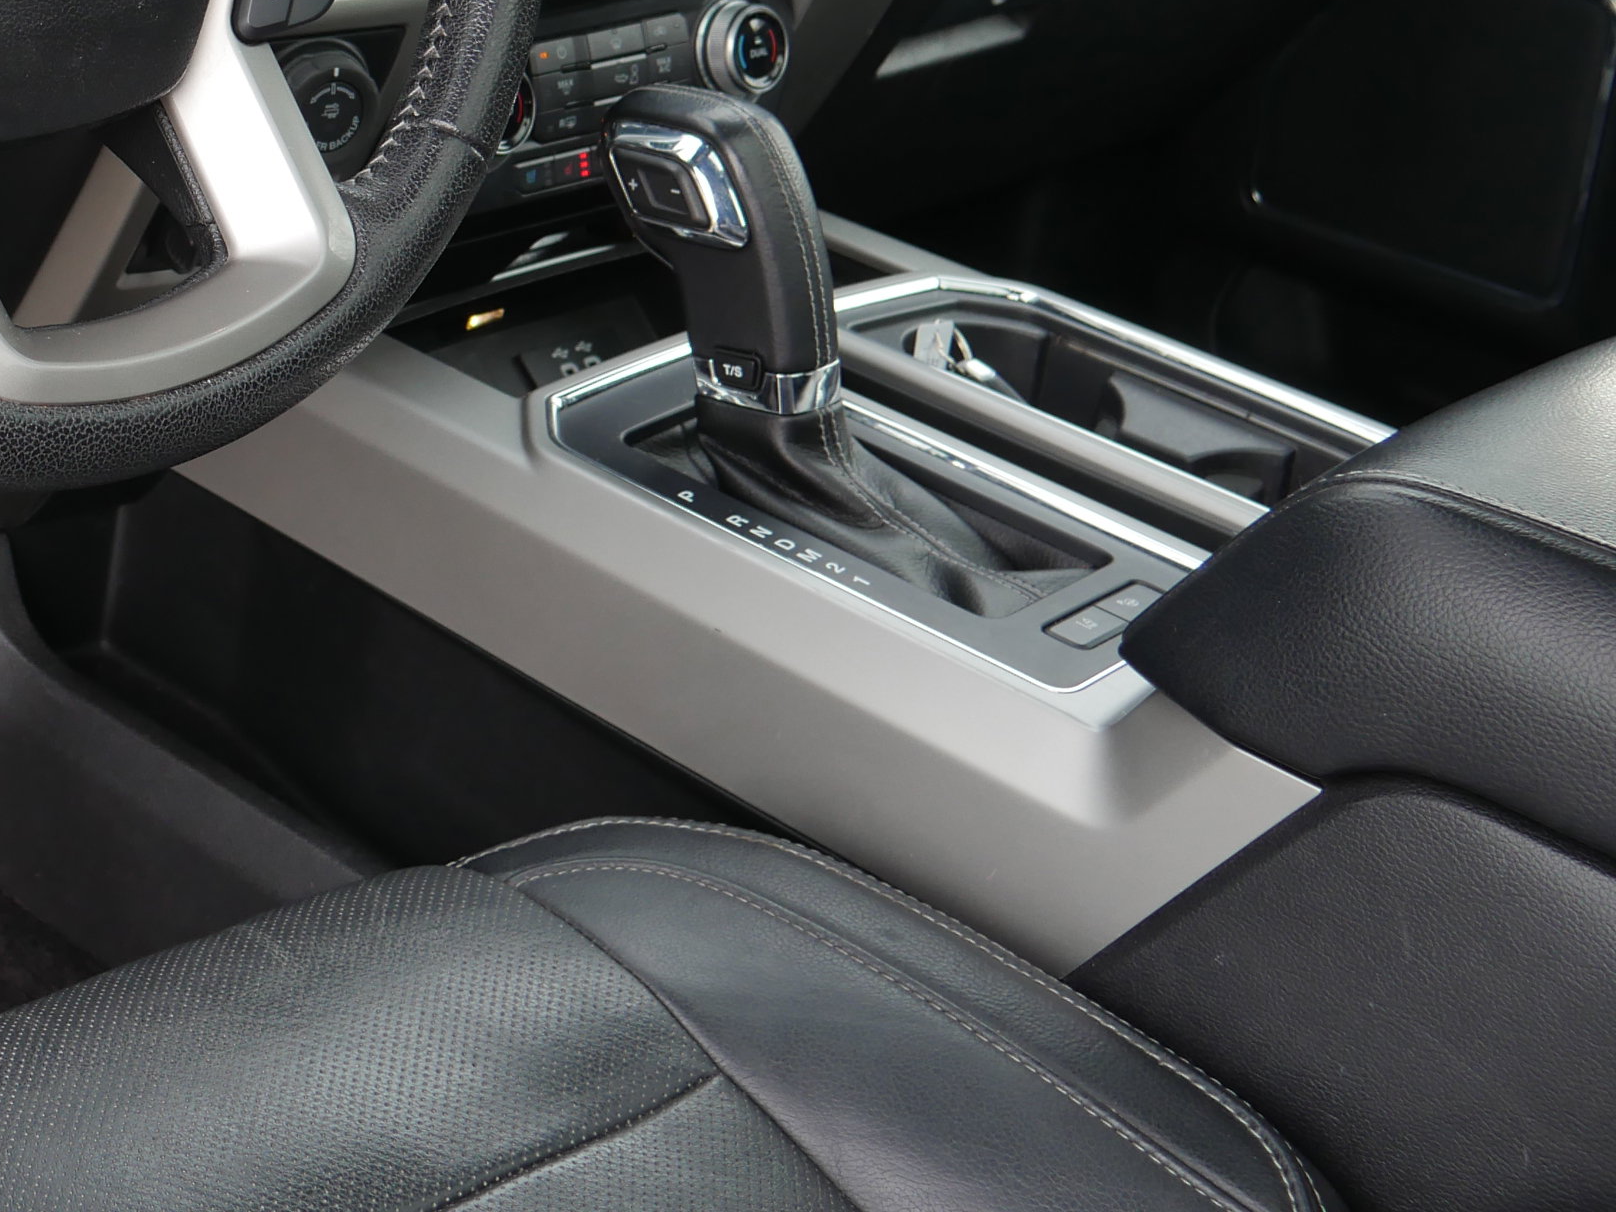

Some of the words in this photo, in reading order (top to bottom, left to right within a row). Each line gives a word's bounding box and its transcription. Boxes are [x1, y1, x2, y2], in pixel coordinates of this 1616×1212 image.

[329, 115, 361, 150] BACKUP
[723, 364, 743, 378] T/S
[678, 490, 695, 502] P
[726, 514, 749, 527] R
[749, 525, 773, 538] N
[774, 539, 796, 550] D
[796, 548, 822, 563] M
[825, 562, 846, 574] 2
[852, 575, 870, 586] 1
